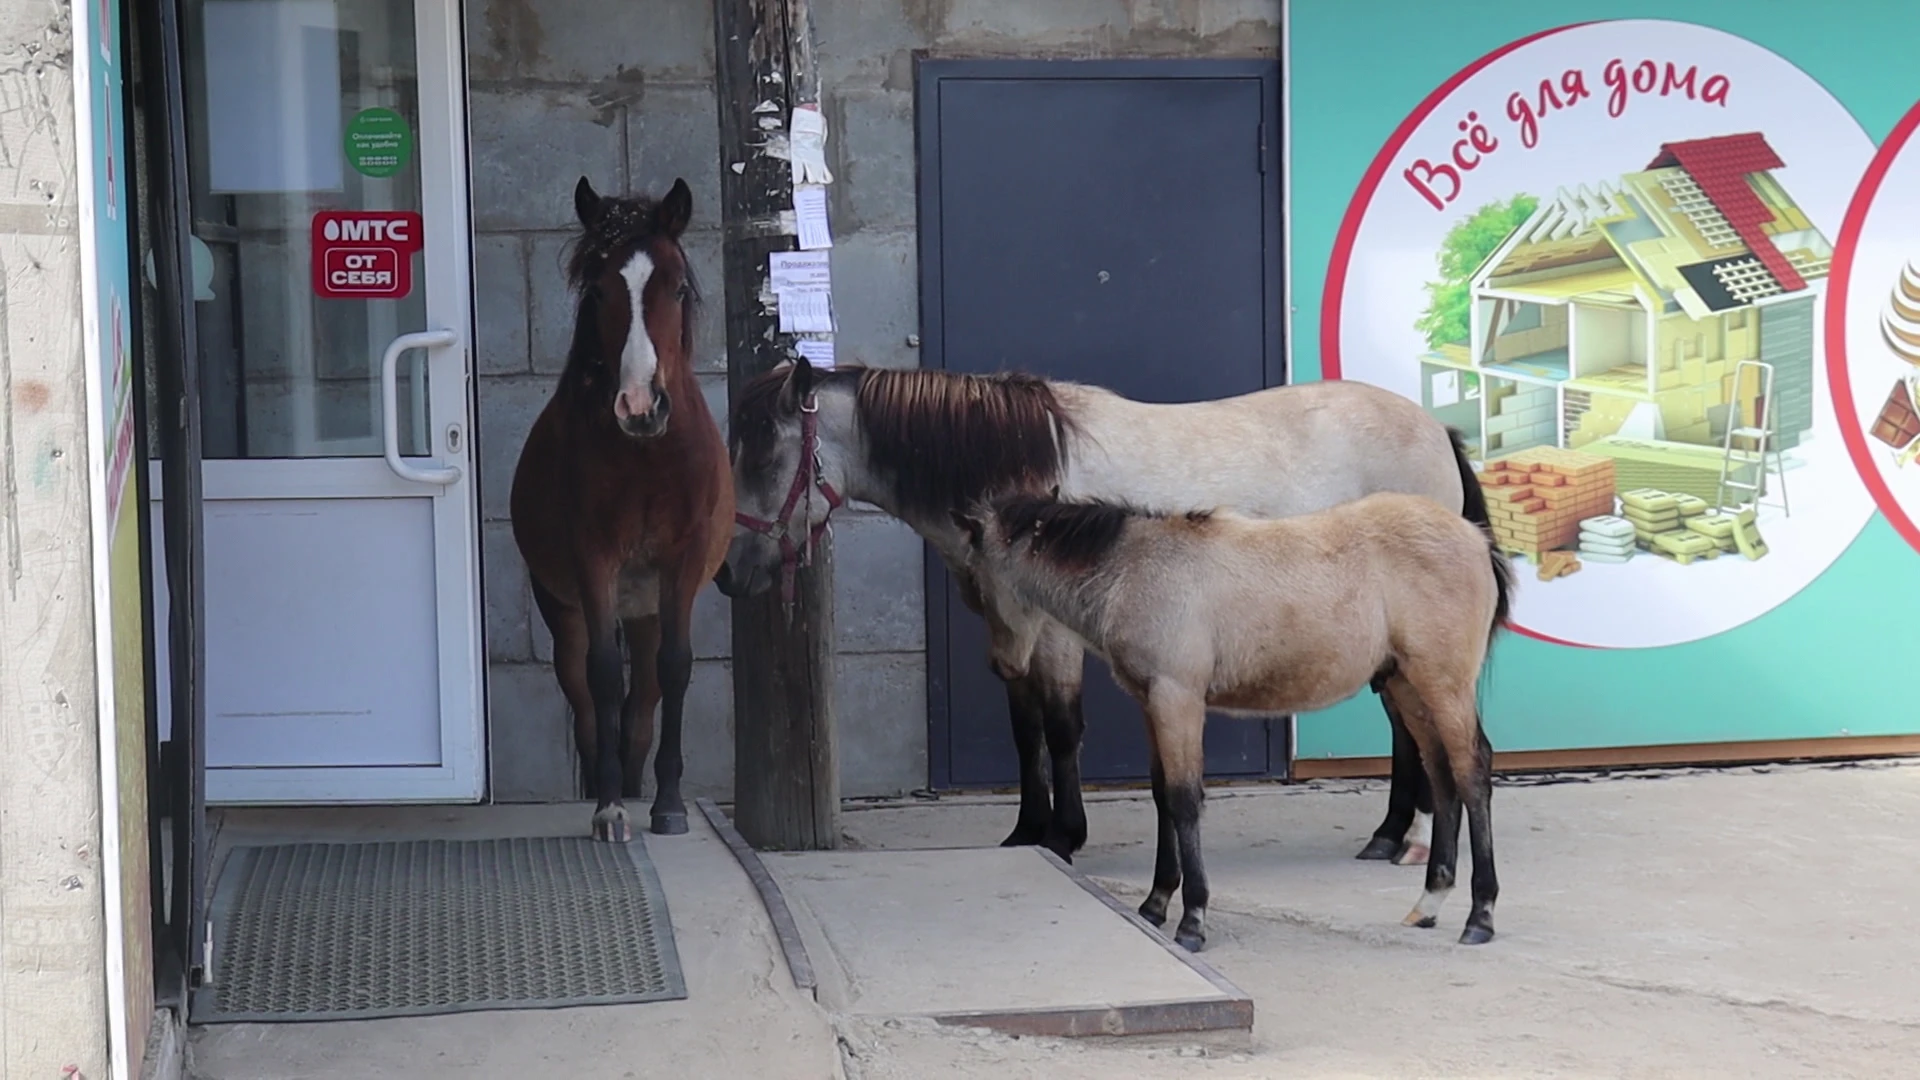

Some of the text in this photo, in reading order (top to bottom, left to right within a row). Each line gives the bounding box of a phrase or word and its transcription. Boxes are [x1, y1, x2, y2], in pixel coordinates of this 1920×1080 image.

[1404, 58, 1730, 211] Всё для дома
[341, 220, 408, 241] МТС
[345, 255, 377, 269] ОТ
[331, 271, 391, 285] СЕБЯ
